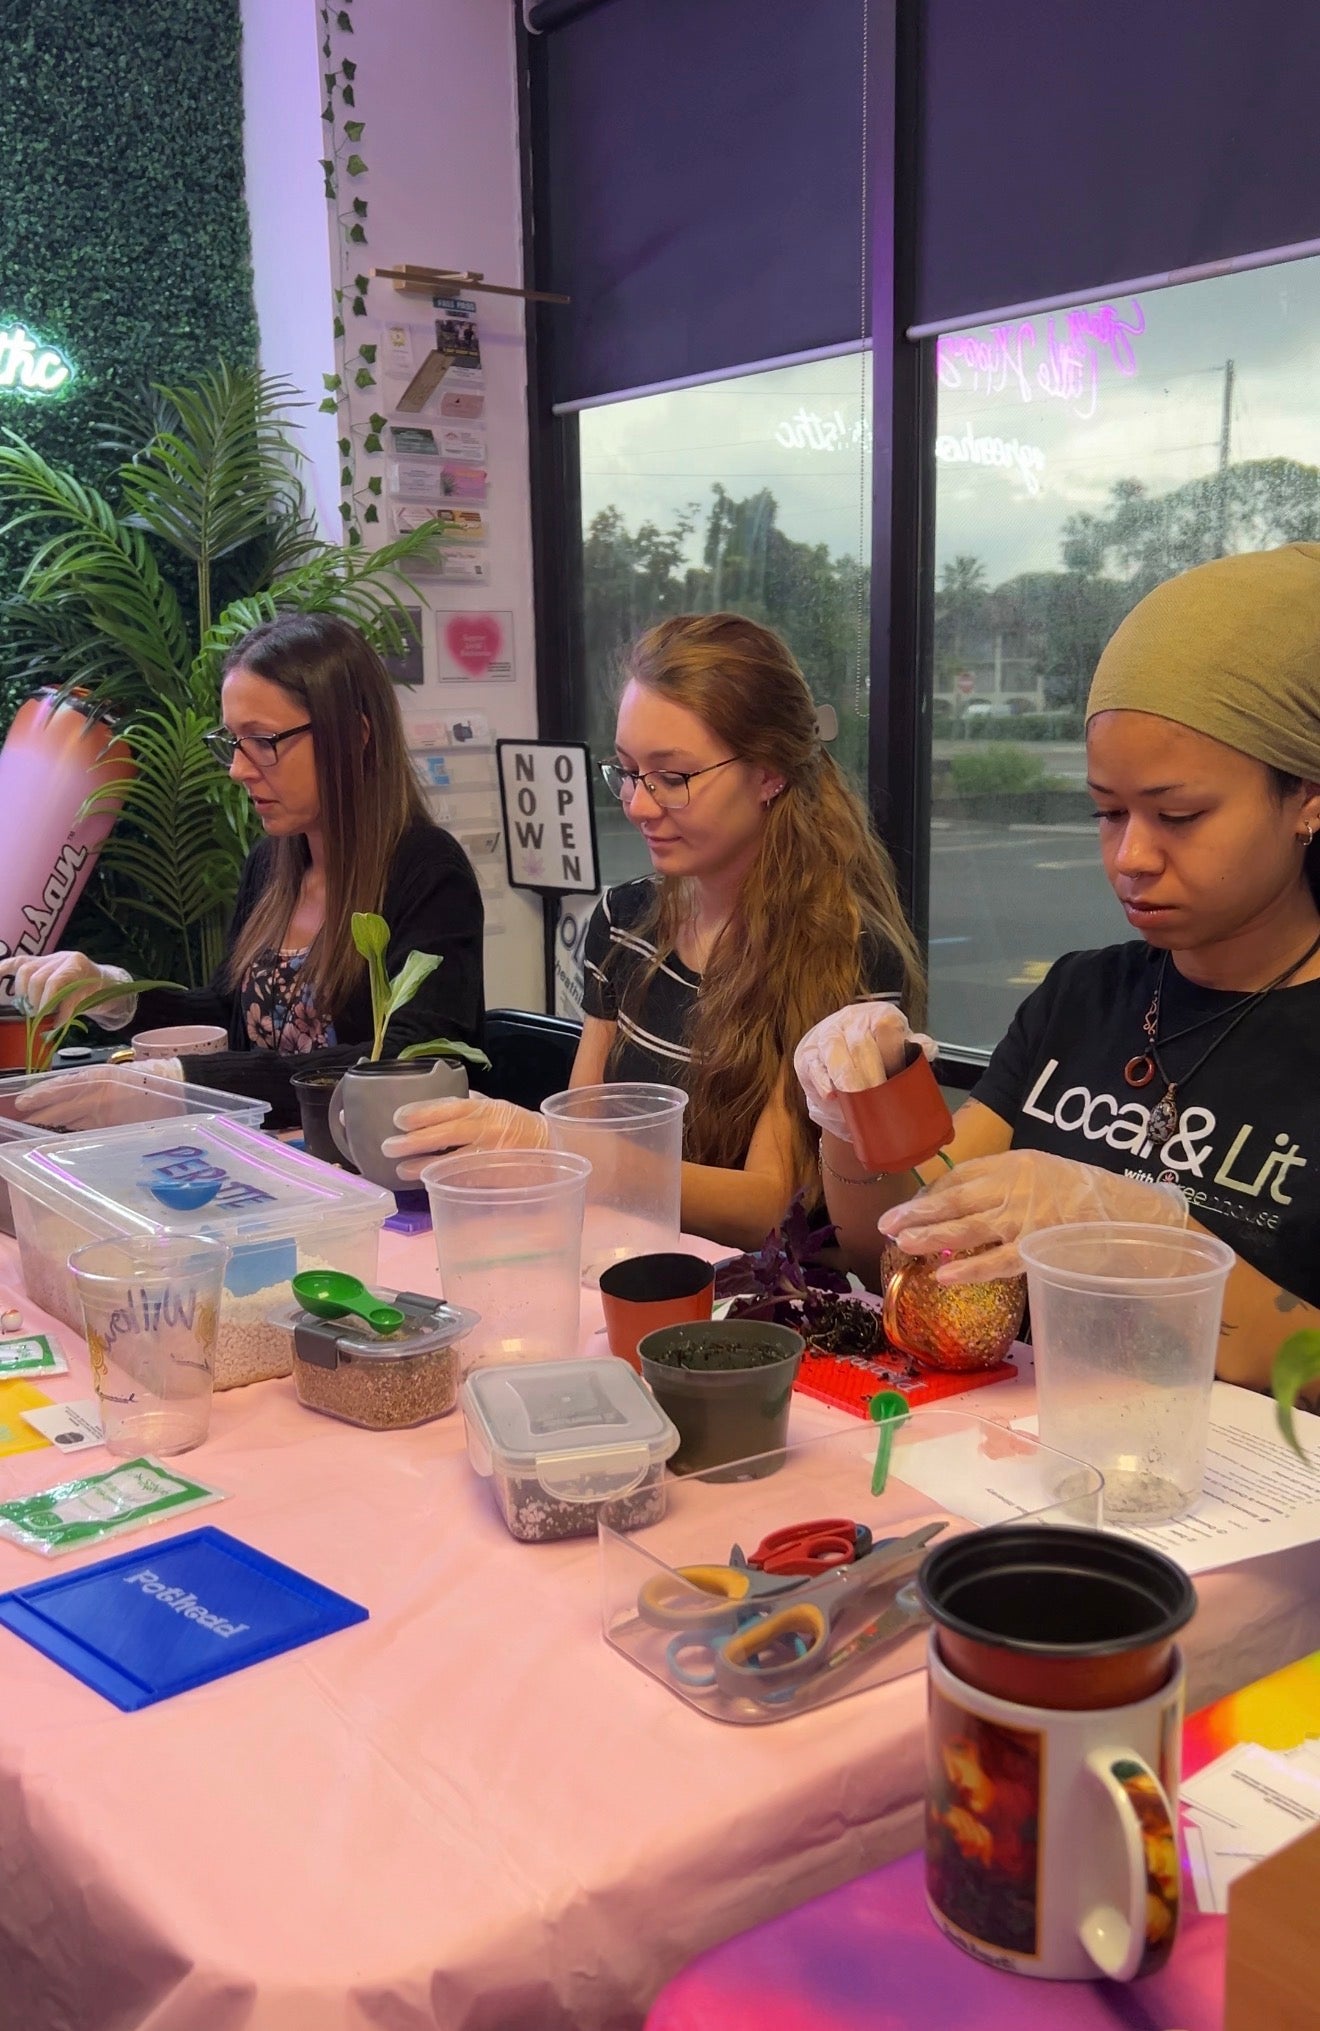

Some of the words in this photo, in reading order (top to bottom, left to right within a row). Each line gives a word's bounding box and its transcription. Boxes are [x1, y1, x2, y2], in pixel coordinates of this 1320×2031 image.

[1022, 1058, 1155, 1160] Loca
[1214, 1124, 1307, 1206] Lit
[142, 1146, 278, 1208] PERITE
[1124, 1168, 1154, 1184] with
[123, 1570, 250, 1638] Pothead
